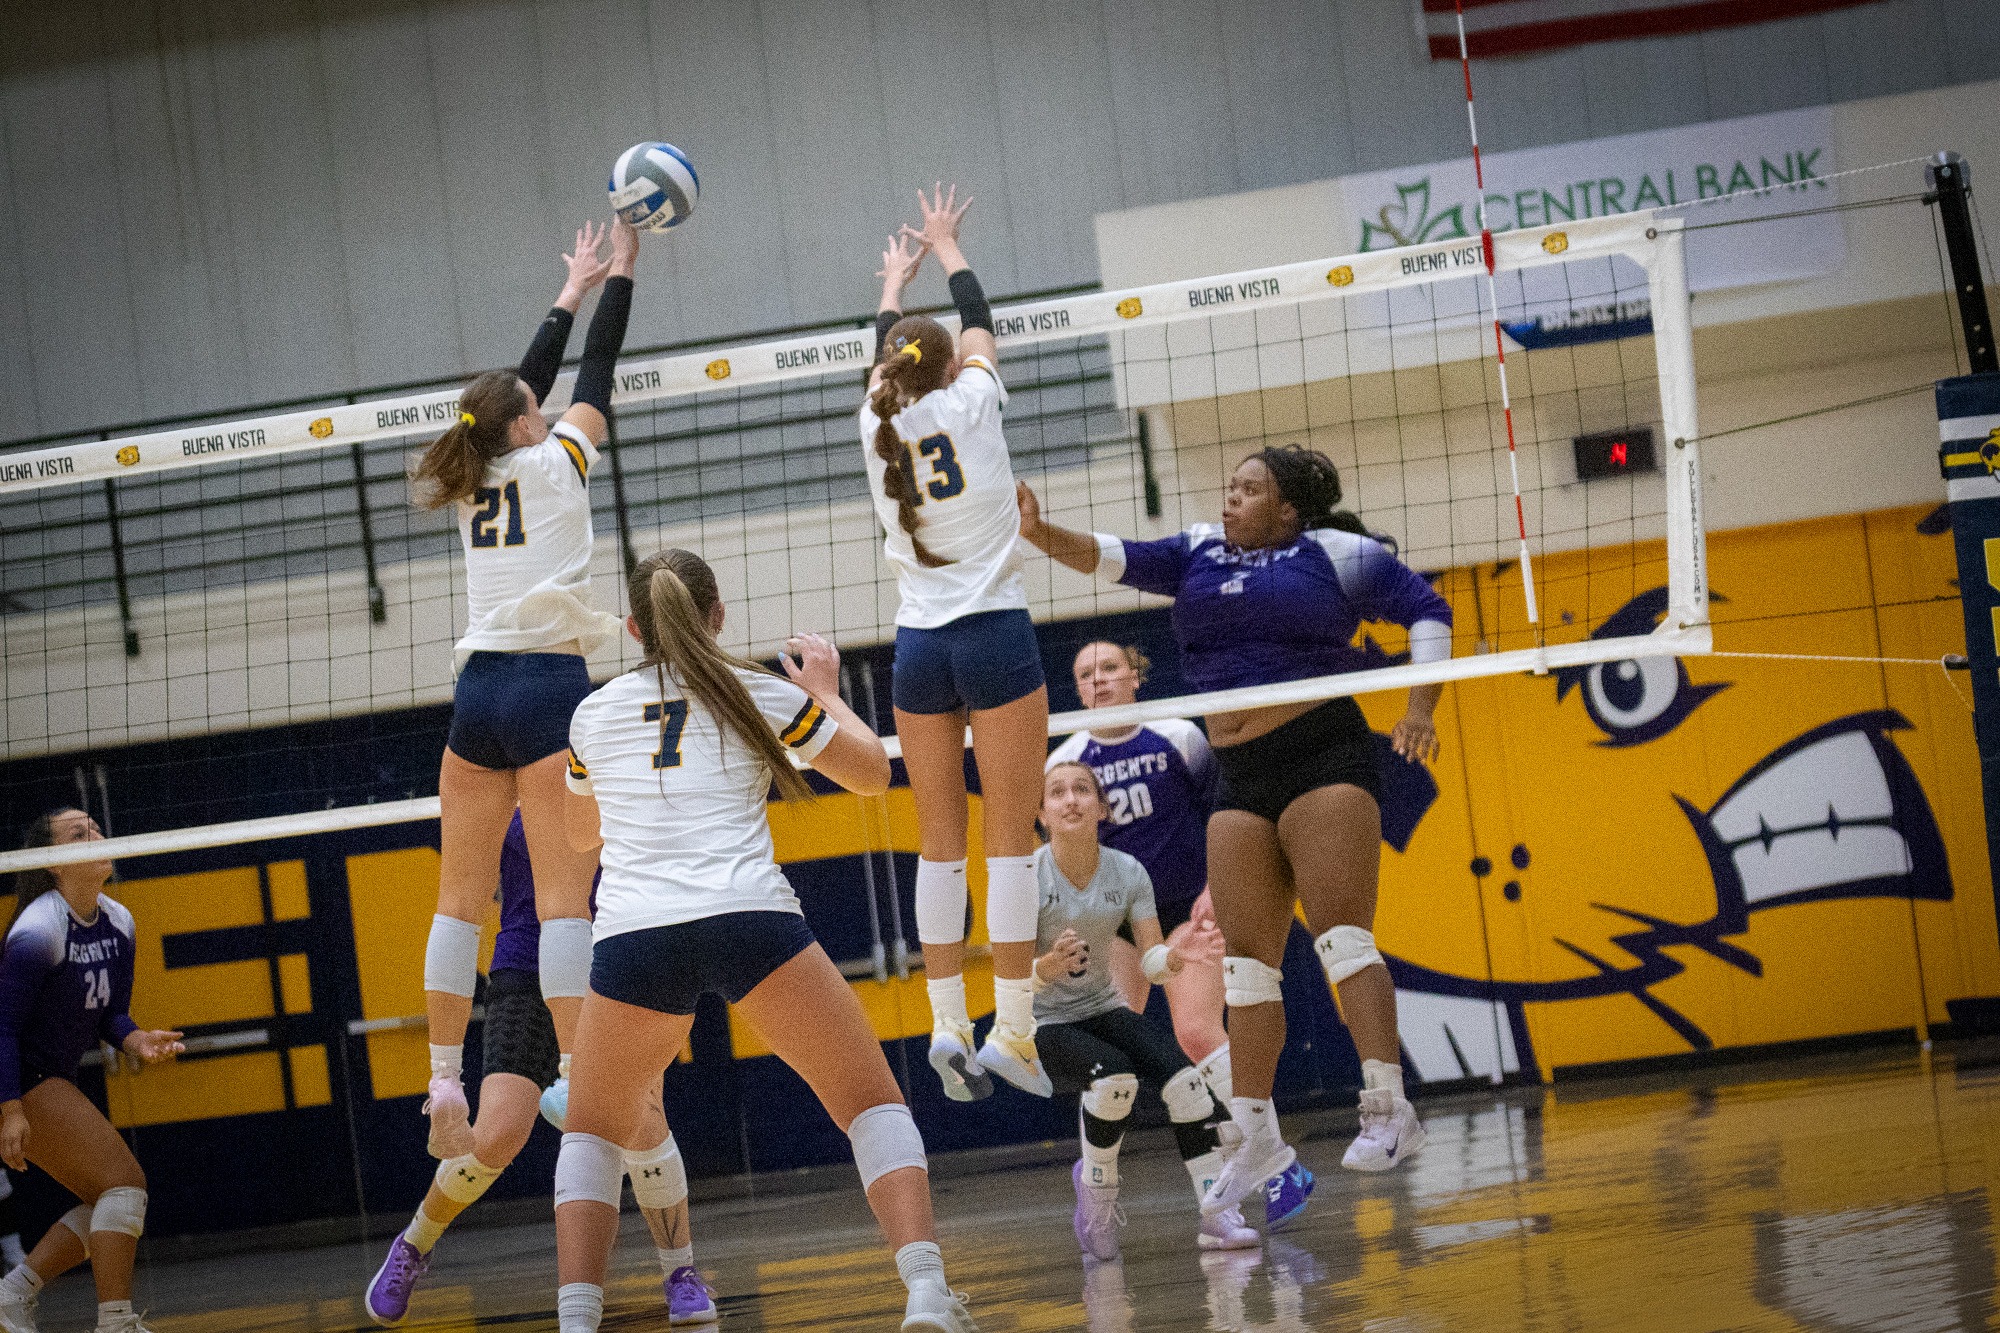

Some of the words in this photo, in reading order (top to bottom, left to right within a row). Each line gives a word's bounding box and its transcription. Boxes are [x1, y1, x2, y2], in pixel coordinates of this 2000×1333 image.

[1475, 168, 1686, 233] CENTRAL
[1696, 148, 1827, 205] BANK
[1401, 252, 1448, 275] BUENA
[1452, 245, 1483, 267] VIST
[1188, 285, 1234, 308] BUENA
[1238, 278, 1281, 300] VISTA
[1029, 309, 1070, 331] VISTA
[776, 346, 820, 370] BUENA
[823, 340, 864, 362] VISTA
[621, 370, 661, 392] VISTA
[376, 406, 420, 428] BUENA
[182, 433, 225, 456] BUENA
[228, 428, 266, 449] VISTA
[0, 462, 33, 482] UENA
[36, 456, 74, 477] VISTA
[471, 479, 527, 548] 21
[642, 697, 691, 770] 7
[1092, 752, 1168, 787] EGENTS
[1108, 783, 1154, 825] 20
[84, 968, 111, 1009] 24
